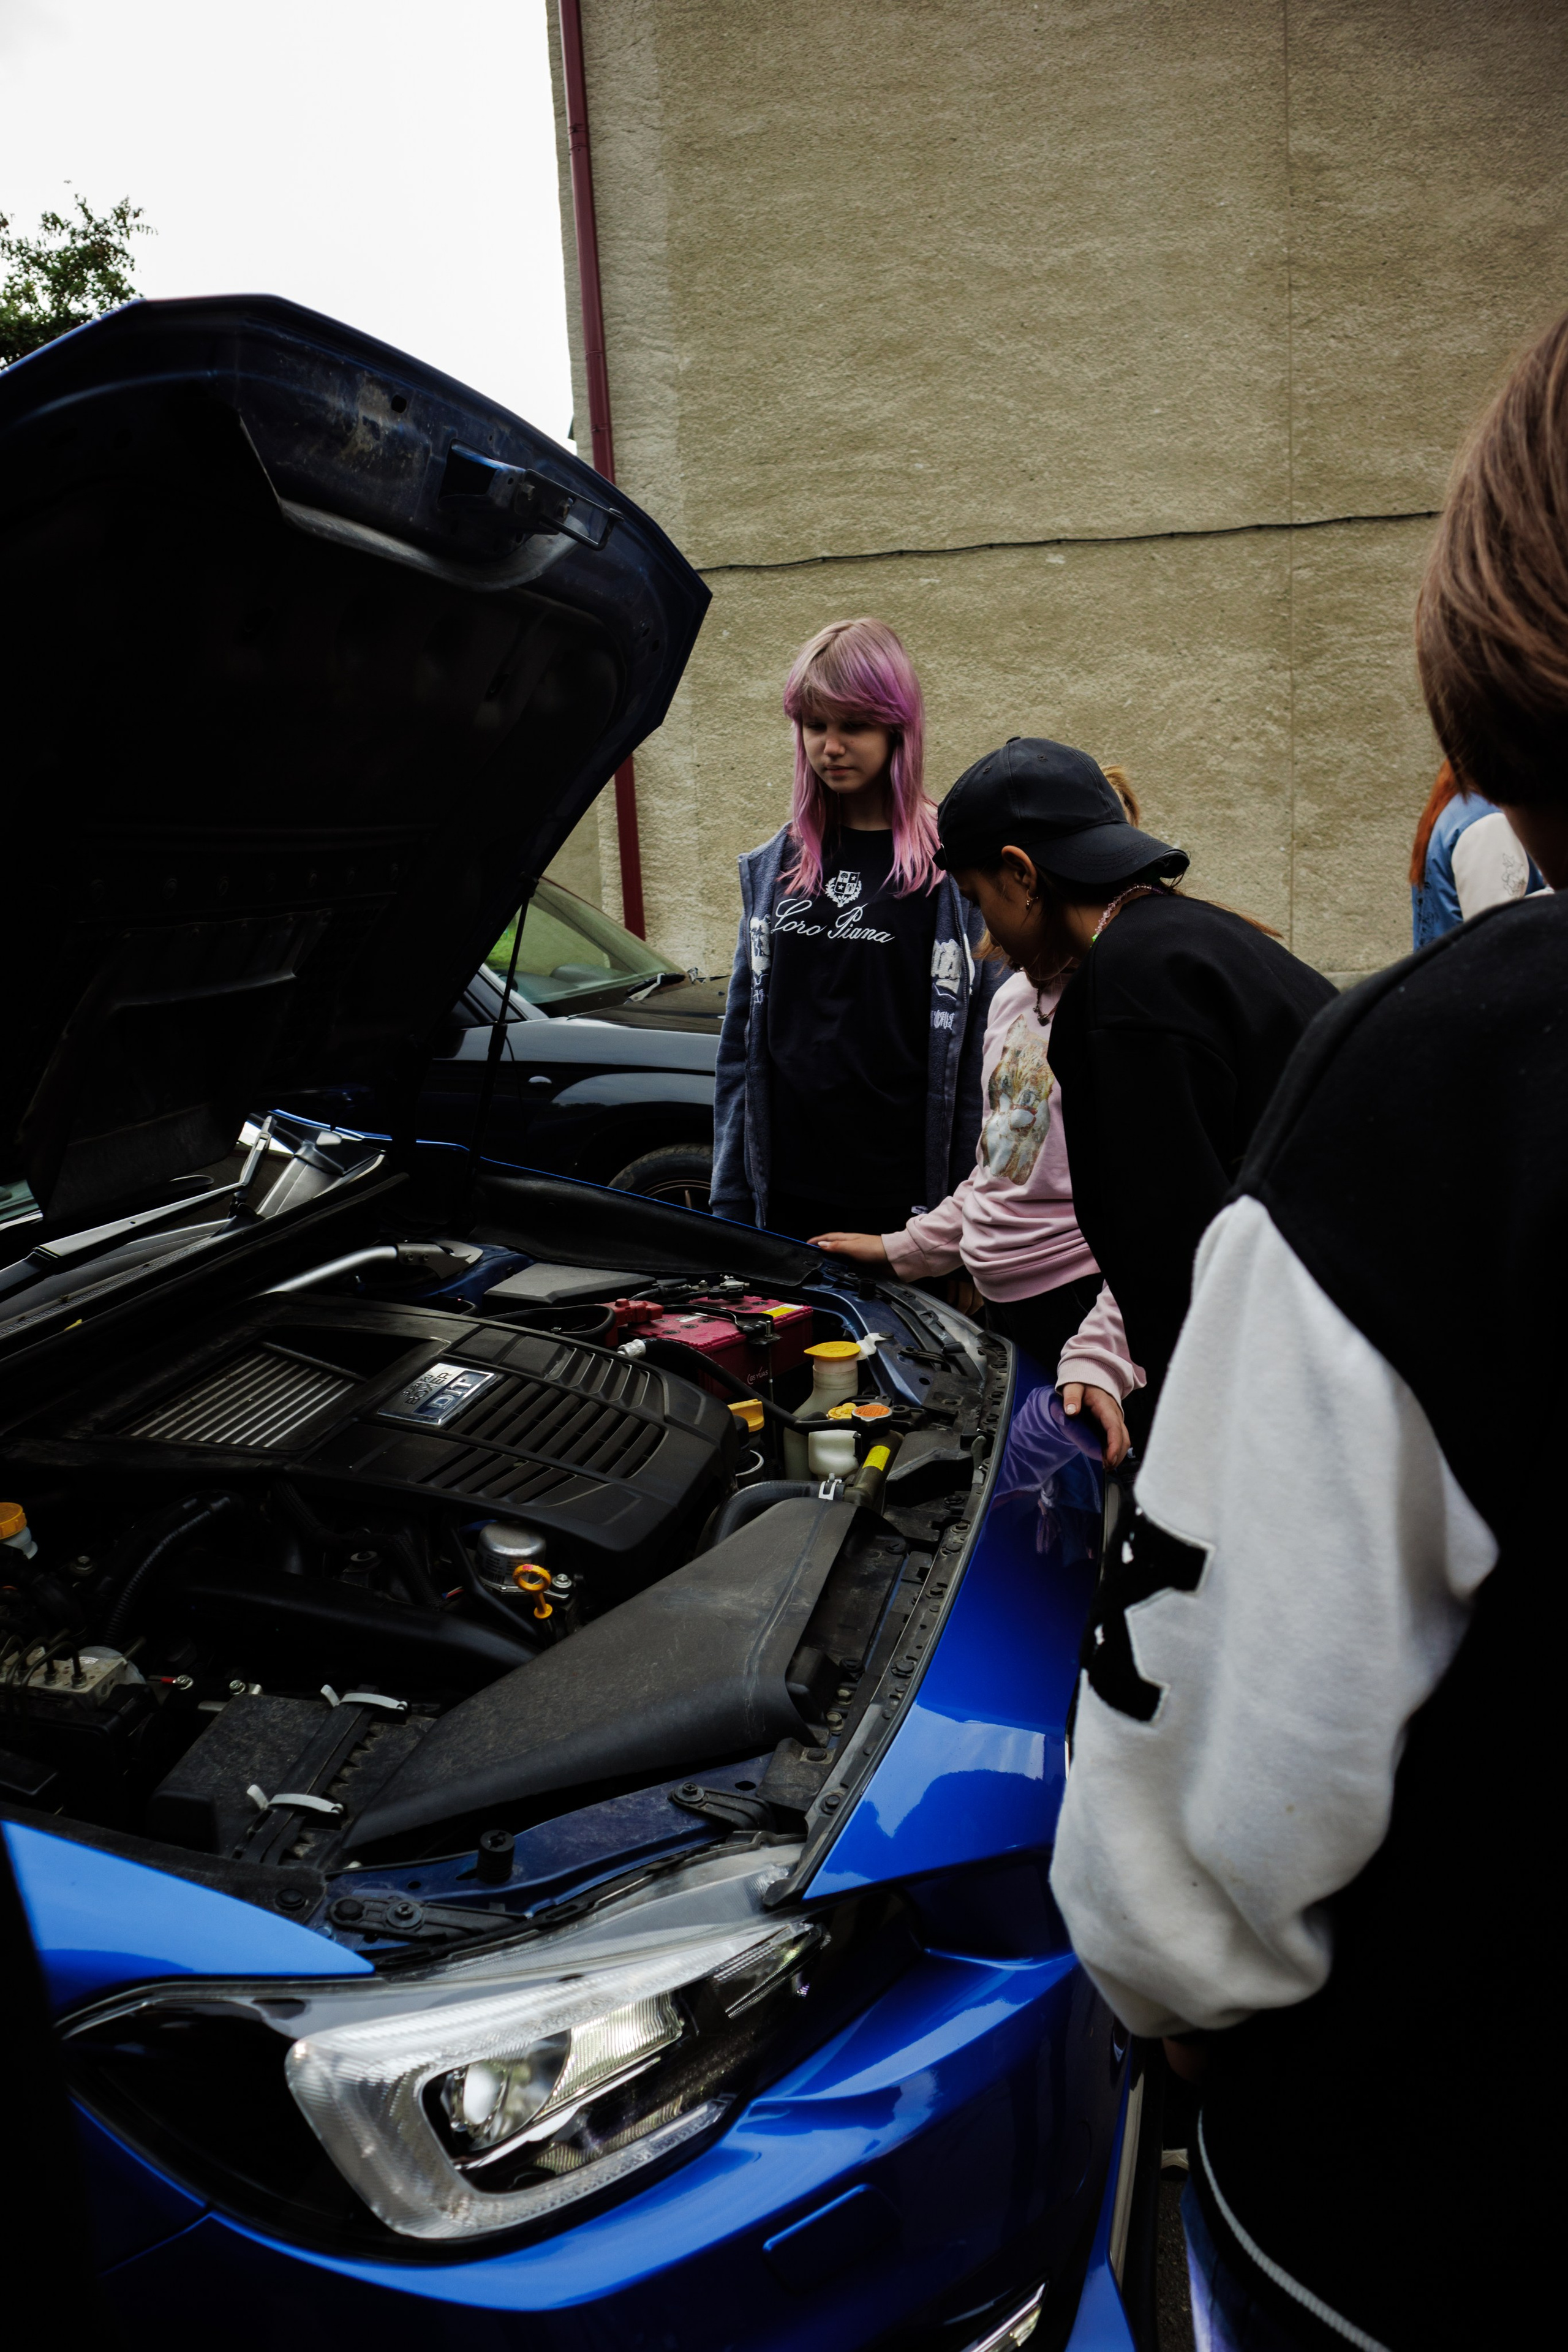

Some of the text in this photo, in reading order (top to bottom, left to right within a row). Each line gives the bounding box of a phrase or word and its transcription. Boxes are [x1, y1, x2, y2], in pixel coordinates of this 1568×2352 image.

[771, 898, 895, 943] Loro Piana
[401, 1374, 434, 1397] SUBARU
[404, 1372, 452, 1405] BOXER
[428, 1378, 472, 1409] DIT
